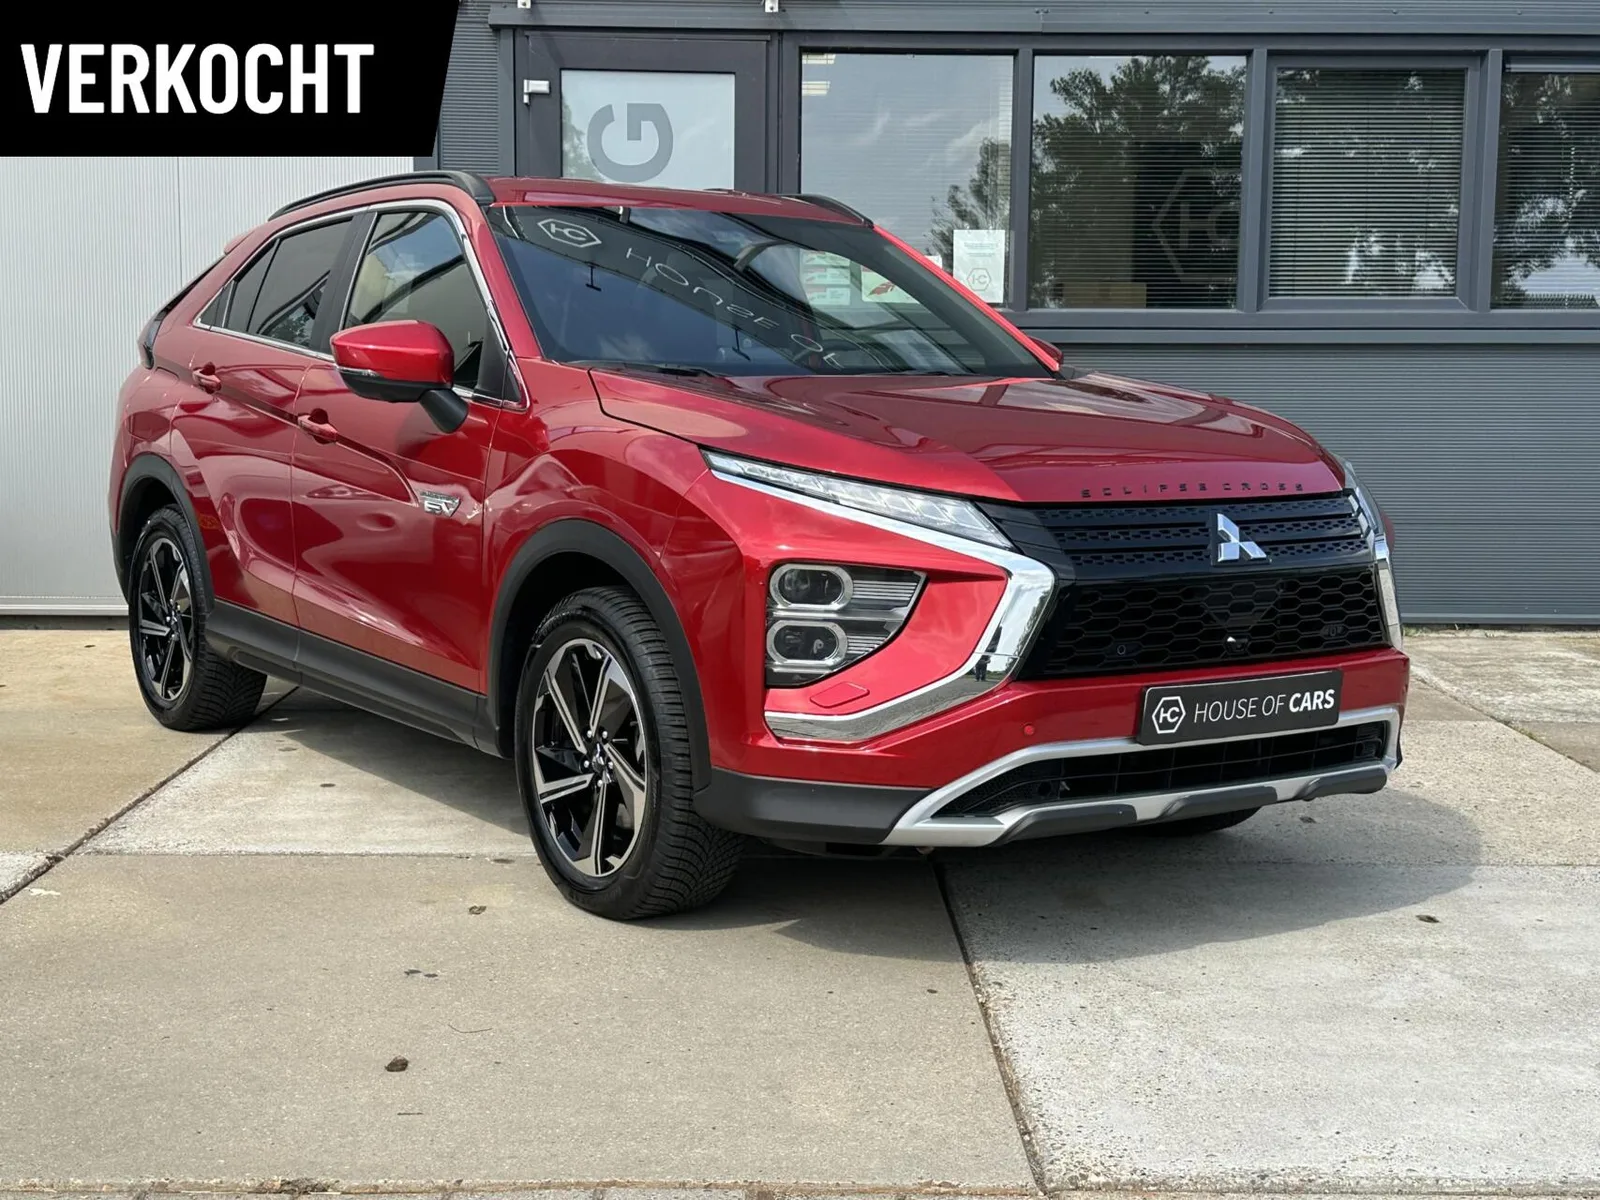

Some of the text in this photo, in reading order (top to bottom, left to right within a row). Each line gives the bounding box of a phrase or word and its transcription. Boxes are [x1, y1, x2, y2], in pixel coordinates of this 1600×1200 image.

[586, 103, 674, 183] G
[1080, 482, 1303, 499] ECLIPSE CROSS
[1193, 697, 1259, 723] HOUSE
[1261, 694, 1287, 717] OF
[1288, 688, 1336, 713] CARS
